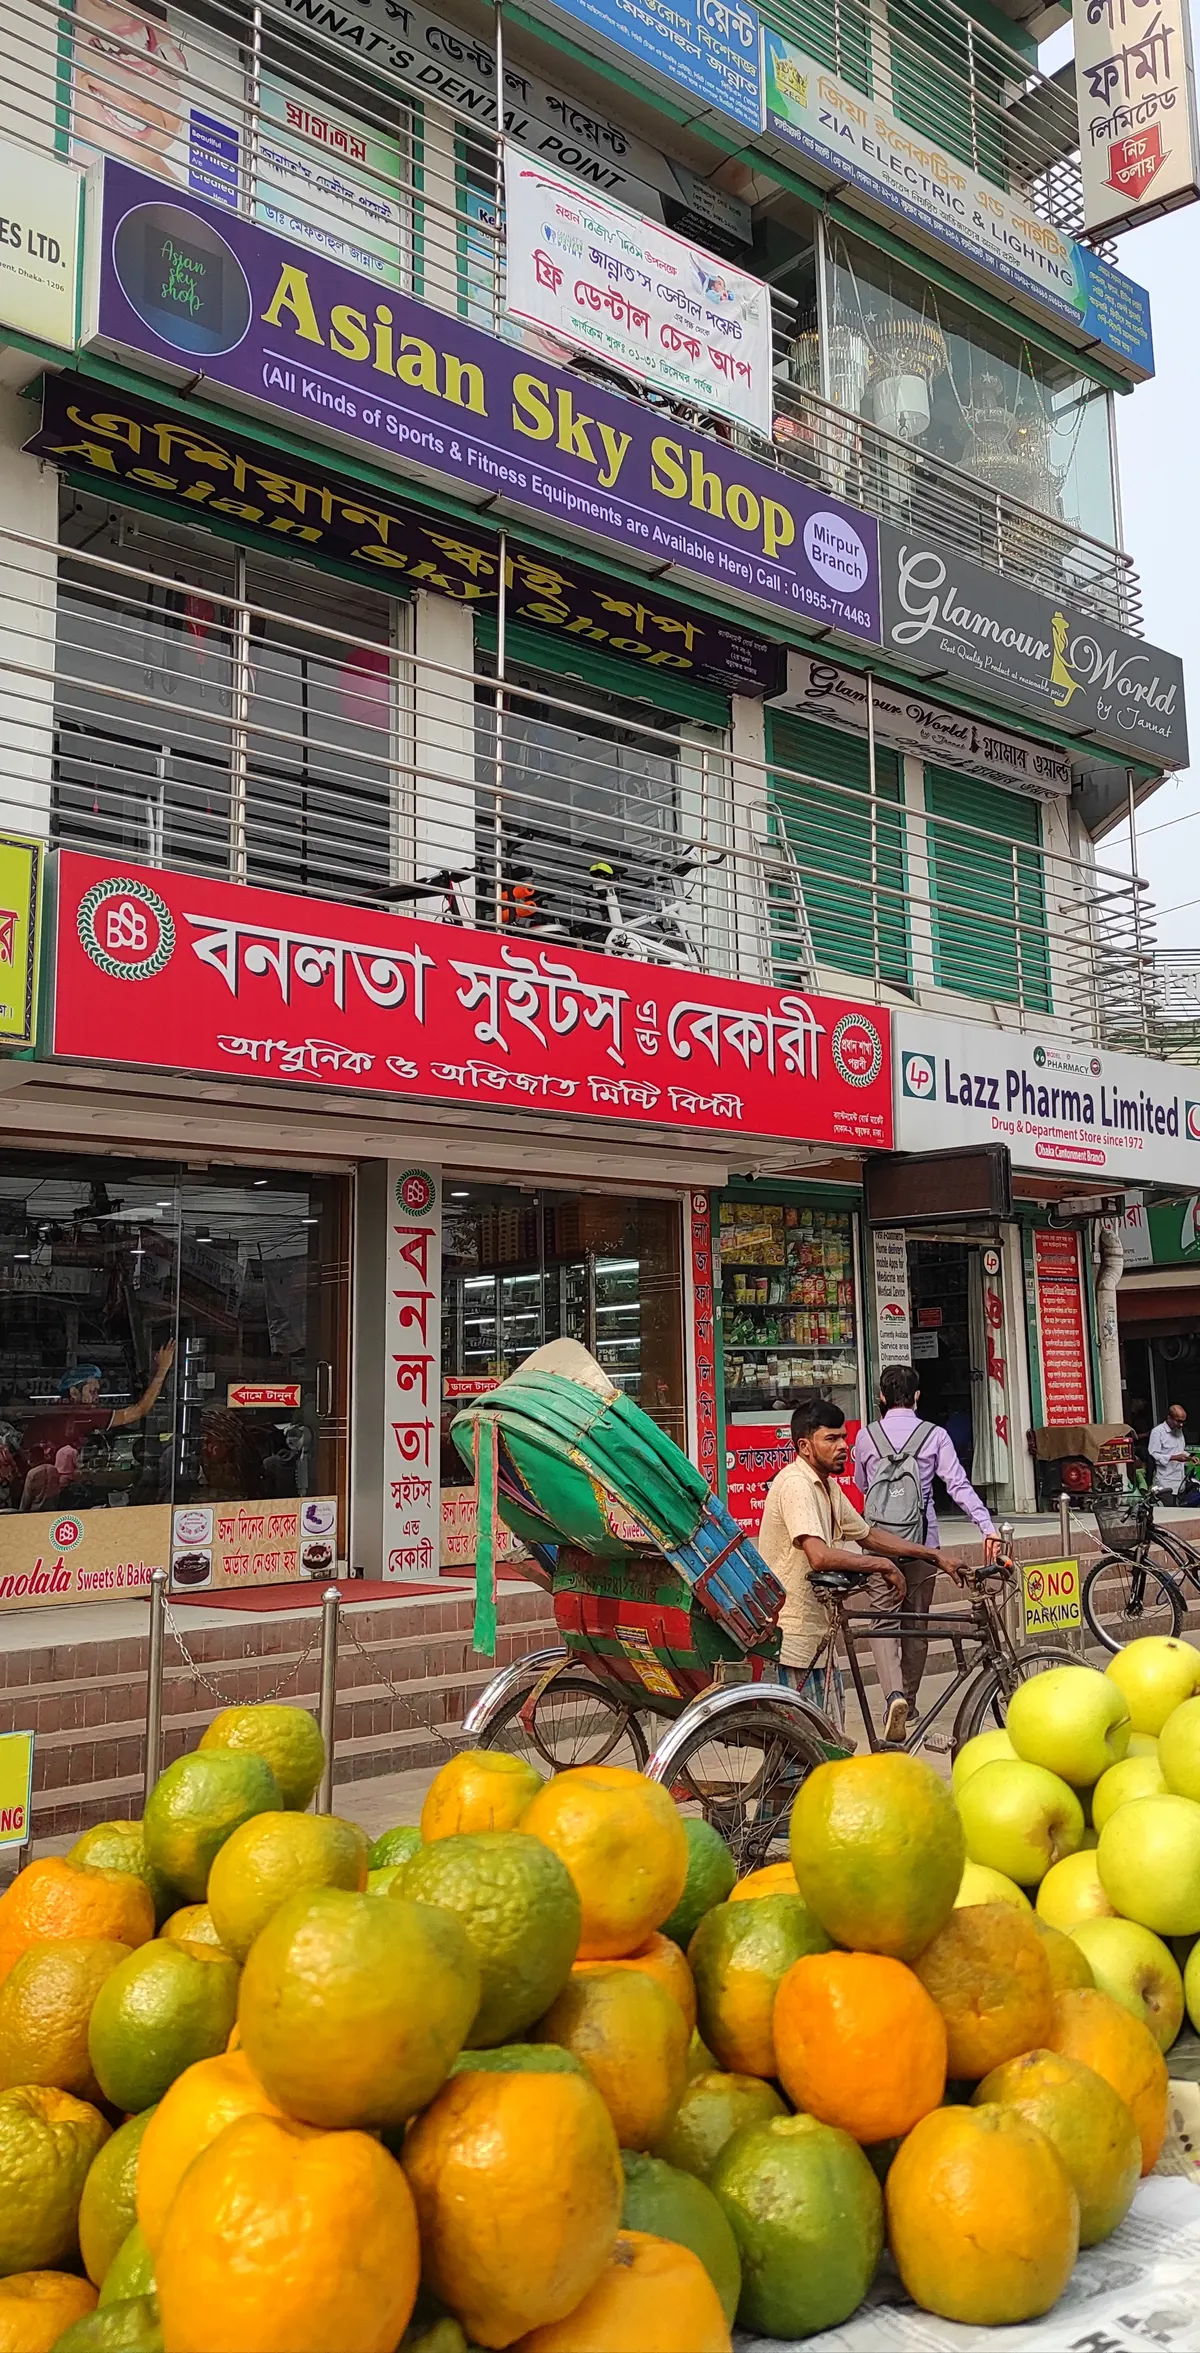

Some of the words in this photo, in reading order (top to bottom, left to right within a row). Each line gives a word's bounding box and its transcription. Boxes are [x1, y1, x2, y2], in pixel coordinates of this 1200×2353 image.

[695, 24, 757, 77] বিশেষজ্ঞ
[1082, 10, 1175, 108] ফার্মা
[705, 52, 759, 96] জান্নাত
[416, 64, 530, 141] DENTAL
[537, 134, 627, 188] POINT
[545, 94, 632, 157] পয়েন্ট
[1087, 86, 1178, 147] লিমিটেড
[1116, 154, 1156, 184] তলায়
[1121, 137, 1148, 164] নিচ
[816, 75, 868, 129] জিয়া
[1009, 209, 1069, 266] লাইটিং
[555, 204, 580, 225] মহান
[818, 106, 856, 145] ZIA
[861, 136, 966, 216] ELECTRIC
[971, 210, 985, 231] &
[992, 222, 1074, 287] LIGHTNG
[28, 228, 66, 269] LTD.
[160, 239, 207, 277] Asian
[160, 281, 205, 316] shop
[168, 267, 198, 293] sky
[530, 249, 565, 296] ফ্রি
[574, 280, 652, 340] ডেন্টাল
[659, 323, 702, 363] চেক
[707, 344, 753, 390] আপ
[656, 283, 702, 321] ডেন্টাল
[706, 310, 743, 340] পয়েন্ট
[260, 261, 488, 417] Asian
[512, 372, 632, 489] Sky
[650, 435, 797, 559] Shop
[262, 362, 297, 394] (All
[302, 375, 358, 419] Kinds
[362, 406, 382, 428] of
[386, 413, 445, 455] Sports
[449, 440, 463, 461] &
[466, 448, 528, 488] Fitness
[531, 475, 623, 529] Equipments
[626, 513, 650, 537] are
[652, 524, 715, 567] Available
[718, 552, 754, 585] Here)
[756, 566, 781, 594] Call
[790, 583, 872, 629] 01955-774463
[65, 405, 407, 546] এশিয়ান
[417, 526, 577, 613] স্কাই
[591, 589, 706, 653] শপ
[812, 521, 860, 560] Mirpur
[41, 439, 325, 544] Asian
[350, 543, 498, 600] Sky
[515, 600, 694, 669] Shop
[811, 543, 863, 581] Branch
[891, 545, 1052, 662] Glamour
[1070, 634, 1177, 716] World
[939, 637, 956, 654] Best
[956, 644, 984, 668] Quality
[984, 655, 1010, 677] Product
[1019, 675, 1050, 693] reasonable
[804, 662, 903, 715] Glamour
[905, 703, 967, 742] World
[1096, 694, 1113, 722] by
[1115, 705, 1173, 739] Jannat
[182, 912, 438, 1027] বনলতা
[448, 945, 634, 1067] সুইটস্
[667, 995, 829, 1082] বেকারী
[216, 1034, 377, 1079] আধুনিক
[384, 1056, 420, 1081] ও
[430, 1059, 581, 1099] অভিজাত
[587, 1075, 663, 1110] মিষ্টি
[1047, 1059, 1090, 1075] PHARMACY
[944, 1058, 1000, 1111] Lazz
[1006, 1069, 1095, 1125] Pharma
[1100, 1085, 1179, 1138] Limited
[991, 1115, 1015, 1136] Drug
[1016, 1120, 1024, 1134] &
[1025, 1121, 1078, 1140] Department
[1079, 1129, 1102, 1145] Store
[1036, 1144, 1055, 1157] Dhaka
[1055, 1145, 1087, 1161] Cantonment
[1086, 1149, 1105, 1164] Branch
[875, 1243, 888, 1253] Home
[888, 1242, 904, 1257] delivery
[876, 1257, 888, 1268] mobile
[888, 1258, 898, 1271] Apps
[876, 1271, 896, 1283] Medicine
[896, 1273, 905, 1283] and
[877, 1286, 892, 1297] Medical
[892, 1286, 906, 1297] Device
[390, 1224, 438, 1468] বনলতা
[880, 1341, 898, 1351] Service
[898, 1342, 909, 1351] area
[881, 1353, 909, 1362] Dhanmondi
[238, 1390, 263, 1401] বামে
[266, 1389, 294, 1402] টানুন
[450, 1382, 473, 1392] ডানে
[389, 1472, 434, 1514] সুইটস্
[238, 1508, 266, 1542] দিনের
[267, 1513, 298, 1539] কেকের
[402, 1518, 422, 1537] এন্ড
[222, 1546, 250, 1577] অর্ডার
[252, 1551, 281, 1576] নেওয়া
[283, 1550, 298, 1574] হয়
[388, 1537, 435, 1575] বেকারী
[77, 1566, 114, 1592] Sweets
[117, 1562, 124, 1587] &
[1048, 1571, 1075, 1597] NO
[1026, 1602, 1080, 1627] PARKING
